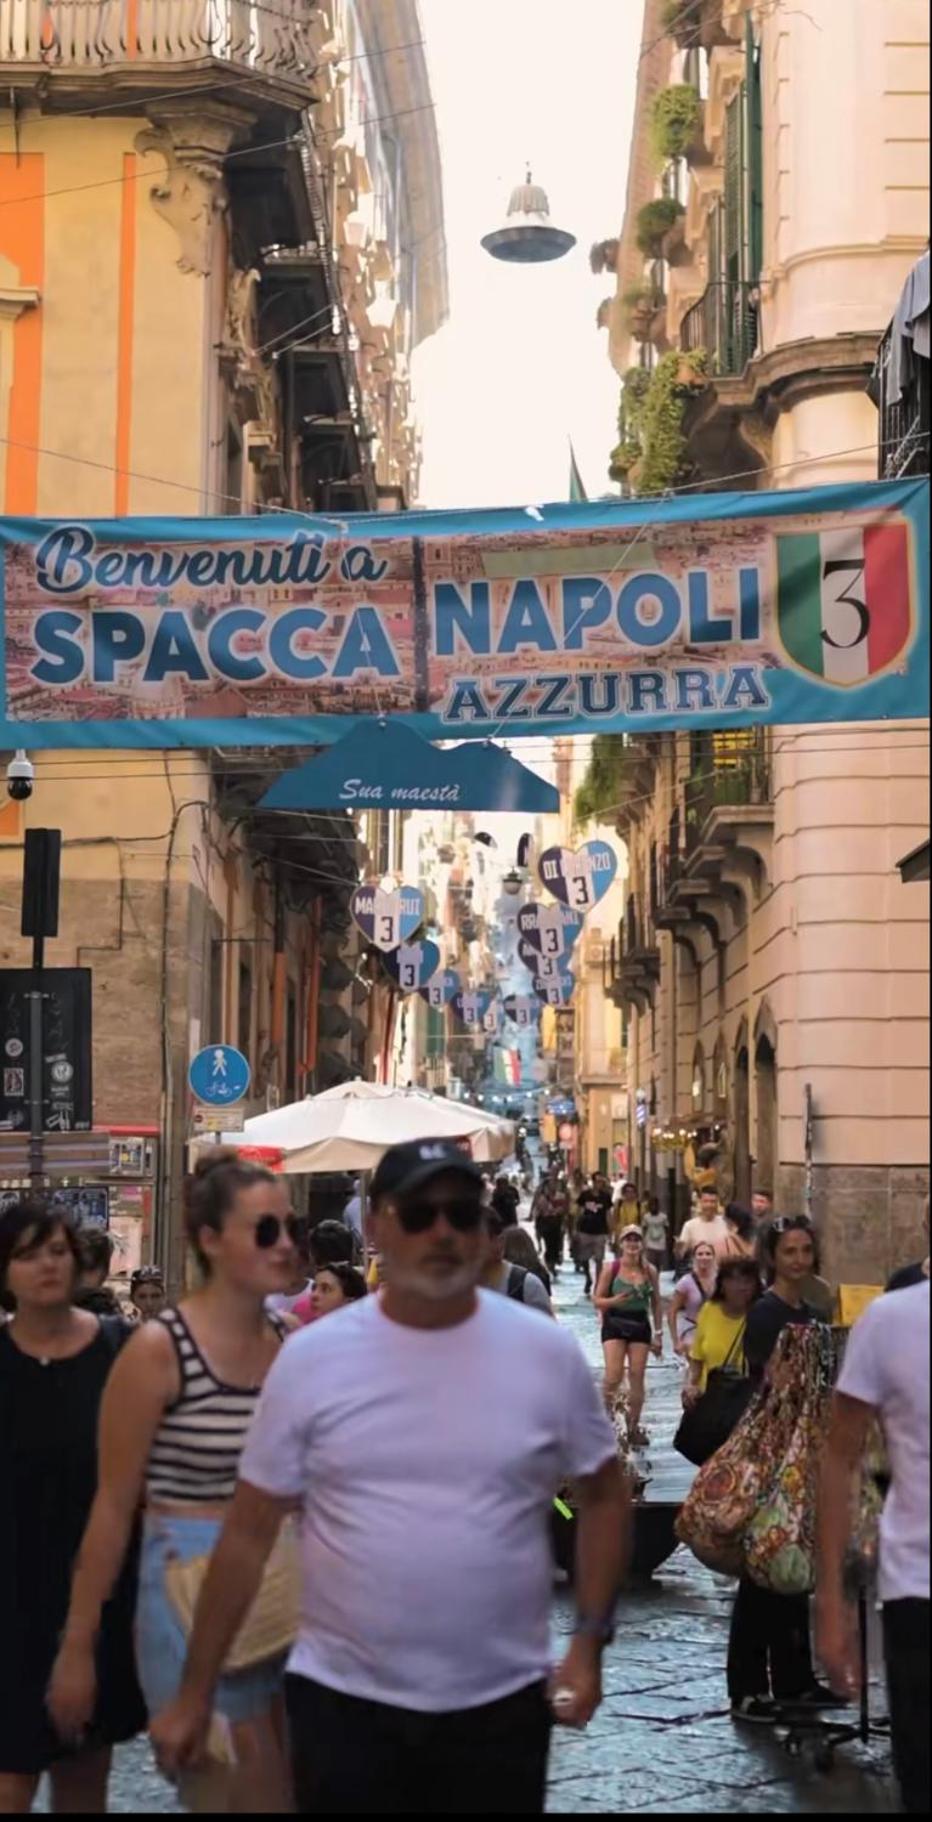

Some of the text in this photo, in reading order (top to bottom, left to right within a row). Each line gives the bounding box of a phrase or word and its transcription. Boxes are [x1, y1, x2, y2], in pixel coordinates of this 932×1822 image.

[36, 526, 387, 593] Benvenuti a
[434, 567, 761, 655] NAPOLI
[820, 558, 871, 649] 3
[31, 607, 399, 683] SPACCA
[444, 665, 769, 723] AZZURRA
[339, 779, 460, 801] Sua maestà
[573, 876, 589, 905] 3
[380, 916, 393, 942] 3
[546, 928, 559, 952] 3
[404, 964, 415, 986] 3
[433, 988, 442, 1005] 3
[551, 991, 560, 1004] 3
[466, 1008, 475, 1023] 3
[519, 1009, 527, 1024] 3
